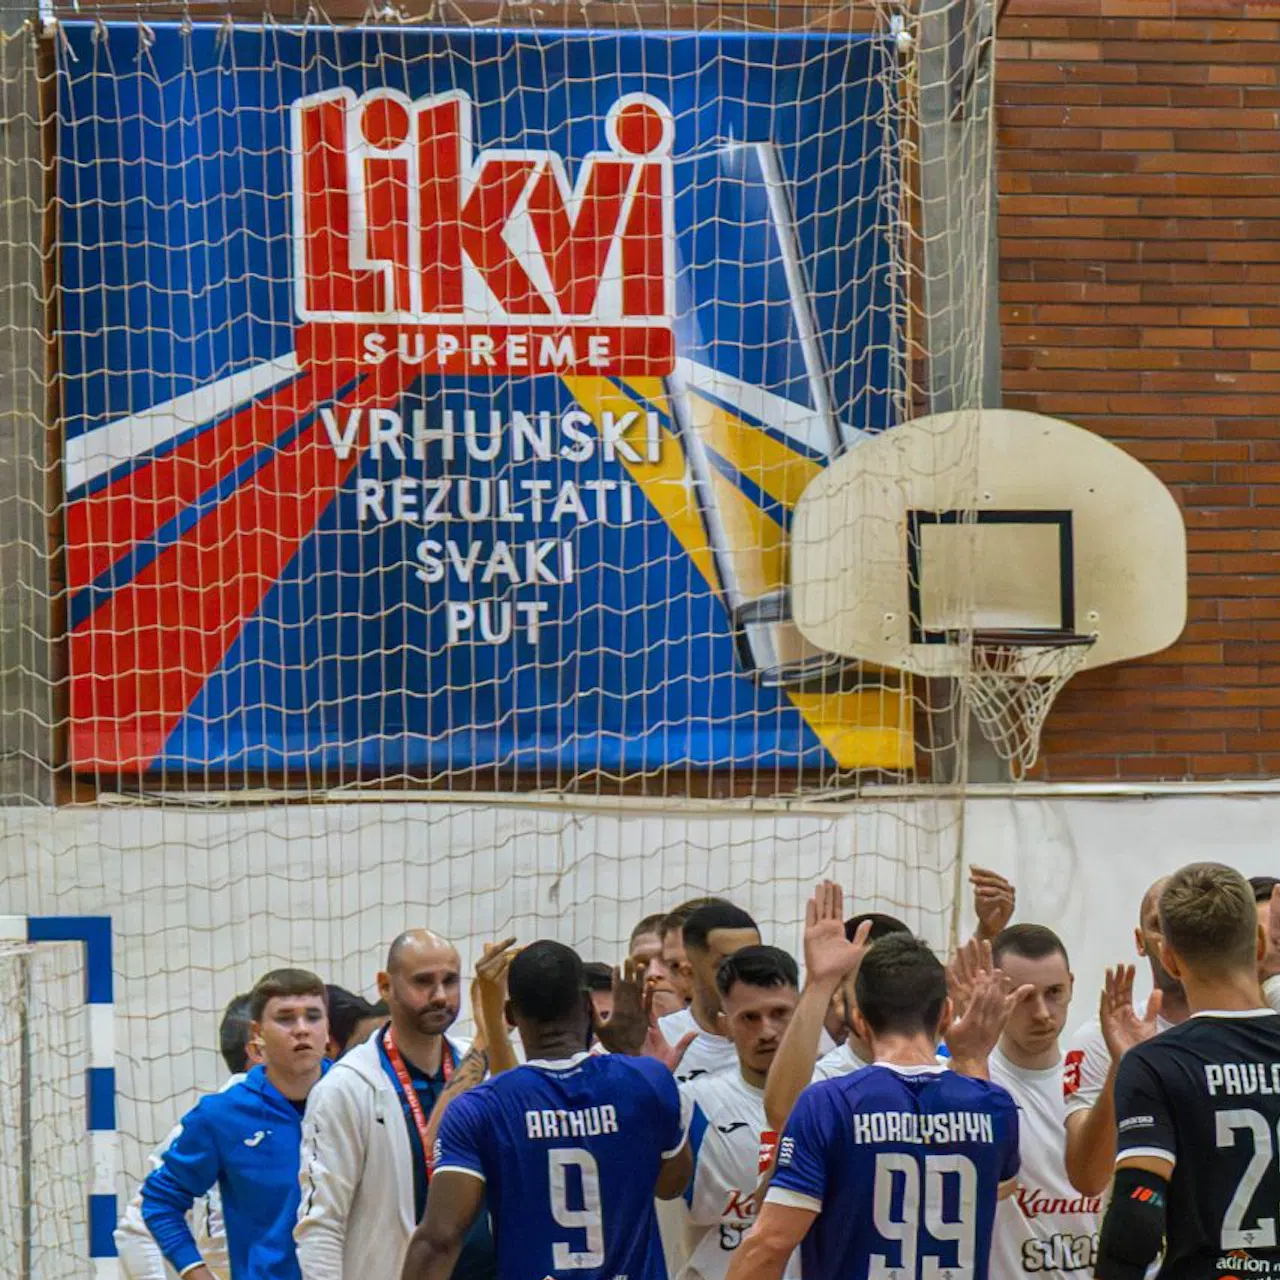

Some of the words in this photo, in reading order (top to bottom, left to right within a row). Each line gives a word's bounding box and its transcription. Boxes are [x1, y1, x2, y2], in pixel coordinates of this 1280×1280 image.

[363, 333, 611, 368] SUPREME
[321, 408, 662, 464] VRHUNSKI
[356, 481, 633, 525] REZULTATI
[415, 540, 574, 584] SVAKI
[446, 601, 548, 645] PUT
[525, 1104, 619, 1139] ARTHUR
[548, 1147, 605, 1271] 9
